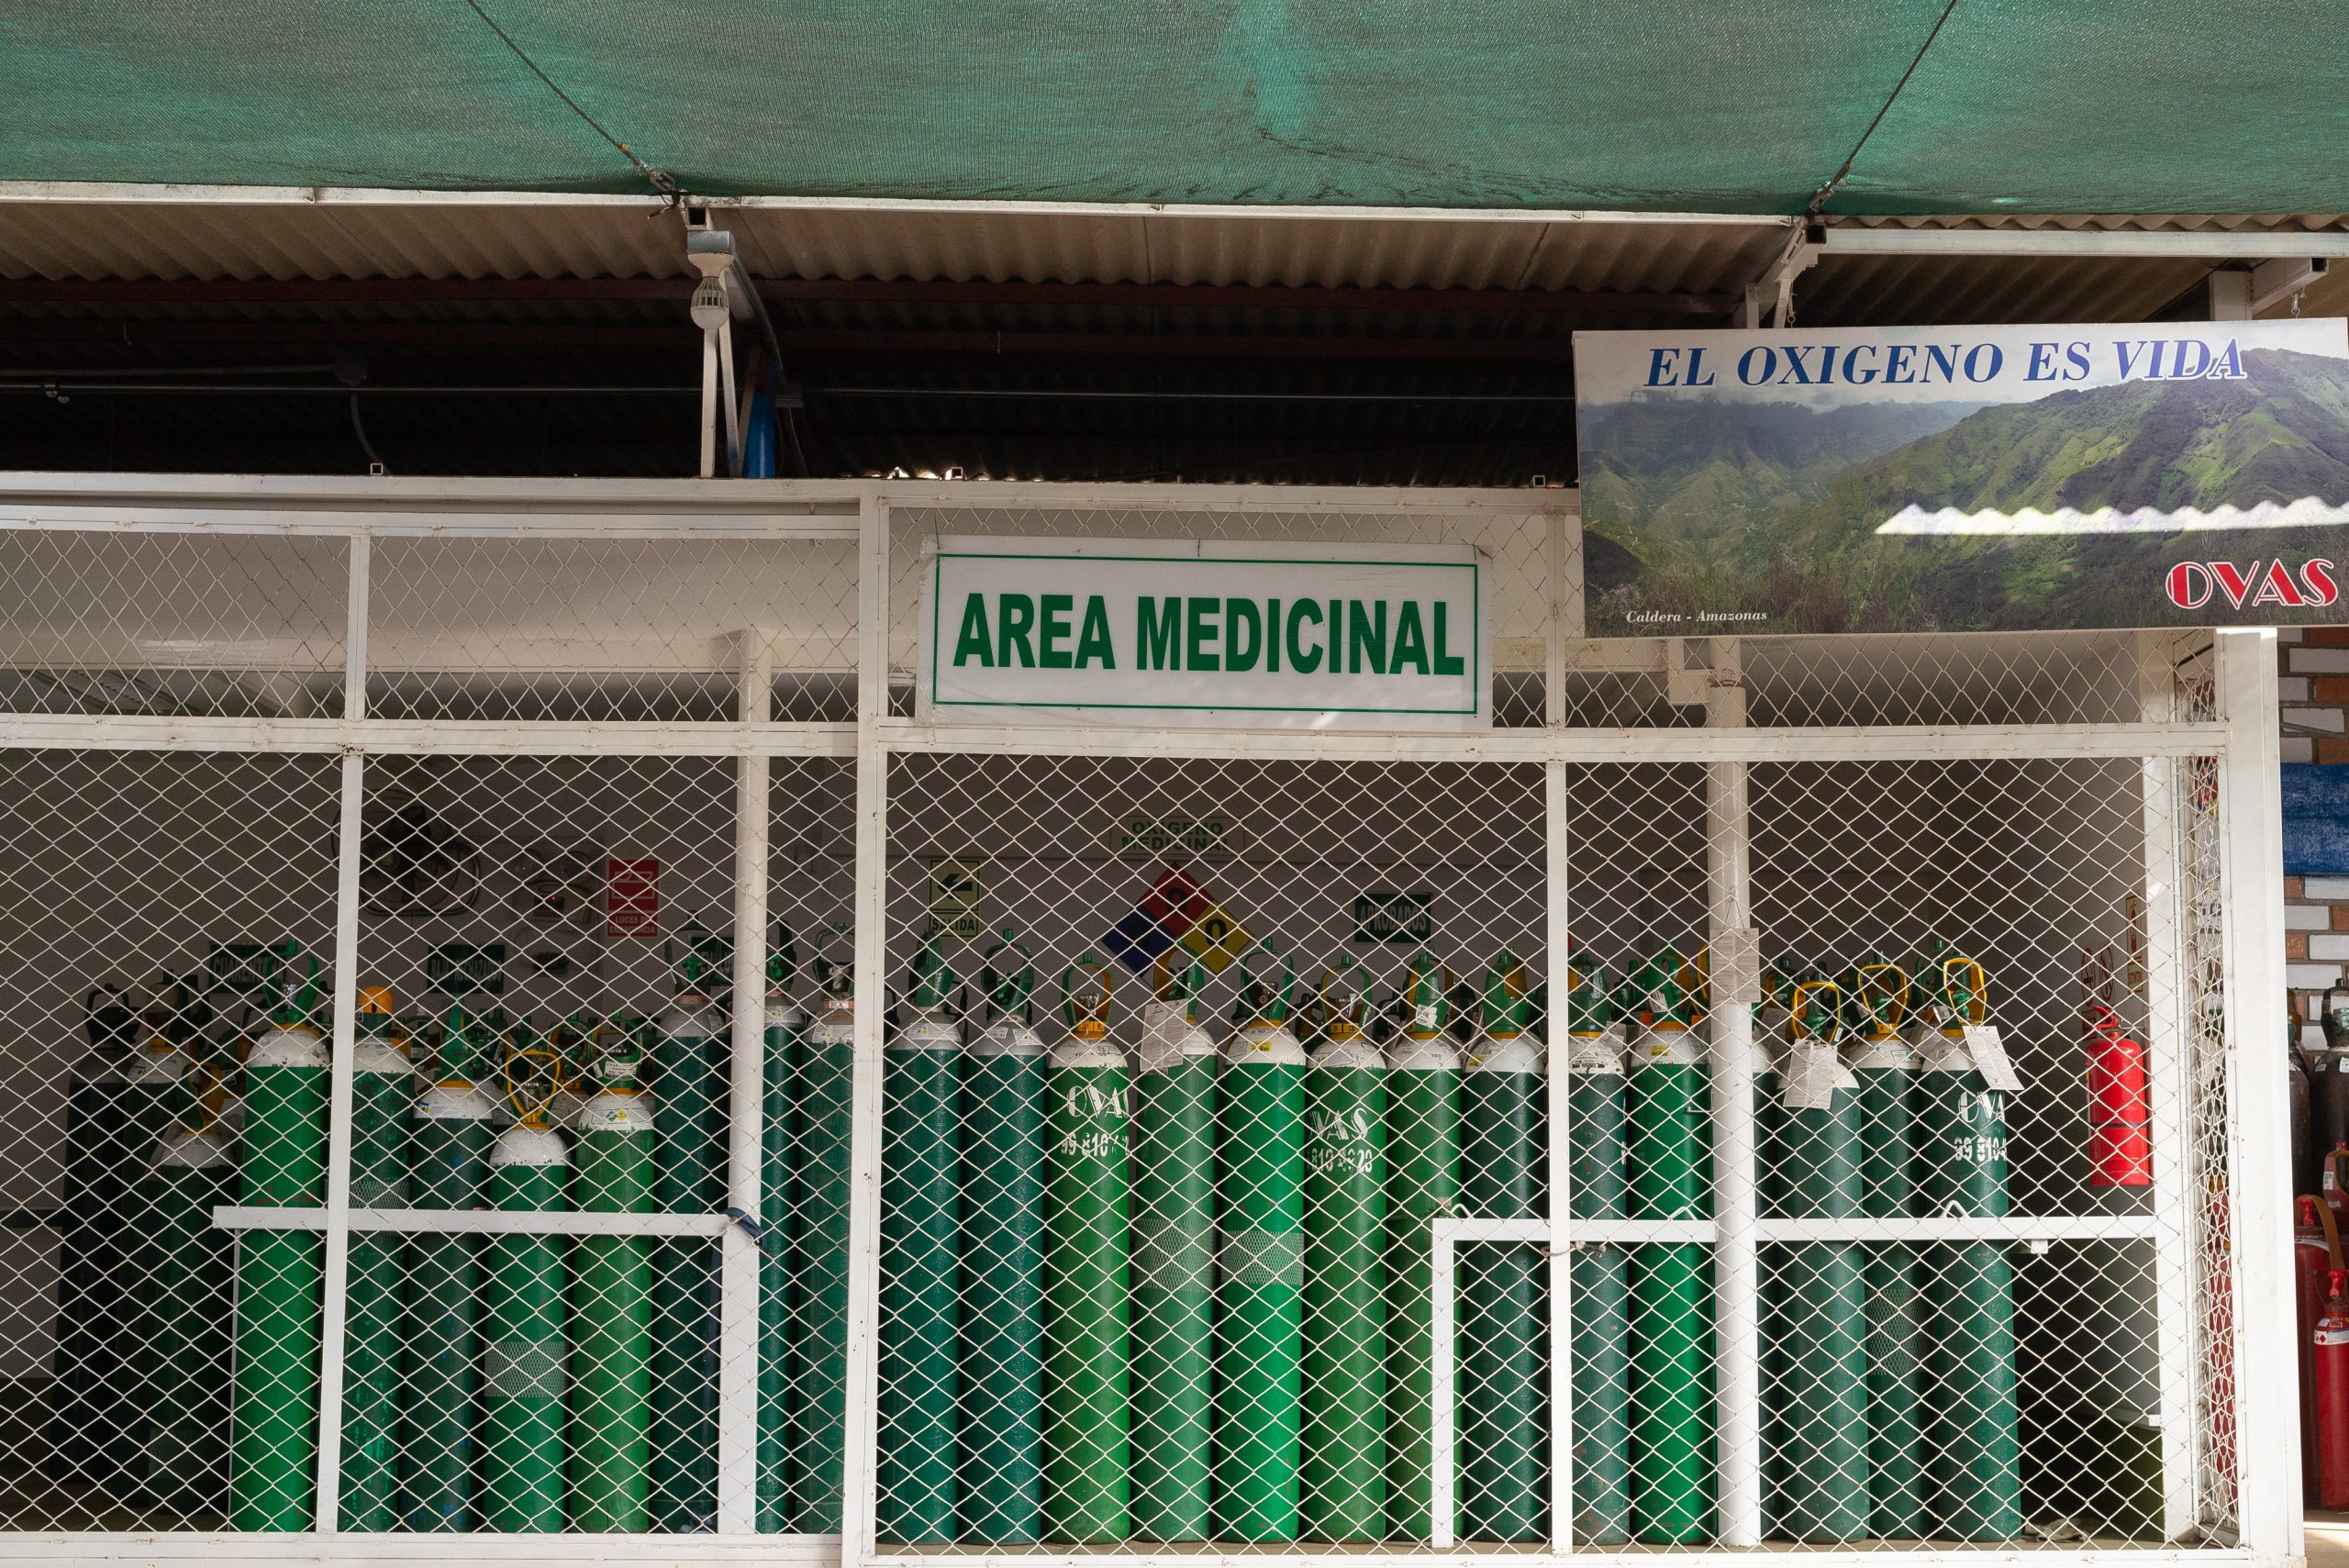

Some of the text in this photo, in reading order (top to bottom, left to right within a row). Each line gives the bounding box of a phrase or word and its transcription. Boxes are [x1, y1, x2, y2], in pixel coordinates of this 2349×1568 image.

[1642, 338, 2248, 387] EL OXIGENO ES VIDA
[2165, 558, 2339, 610] OVAS
[1626, 610, 1682, 623] Caldera
[1696, 609, 1767, 622] Amazonas
[952, 592, 1465, 676] AREA MEDICINAL
[1121, 836, 1232, 851] MEDICINAL
[1165, 887, 1188, 913] 0
[616, 916, 639, 924] LUCES
[931, 918, 975, 931] SALIDA
[1360, 904, 1427, 931] APROBADOS
[1205, 918, 1228, 947] 0
[213, 955, 285, 983] CUARENTNA
[1308, 1107, 1368, 1140] VAS
